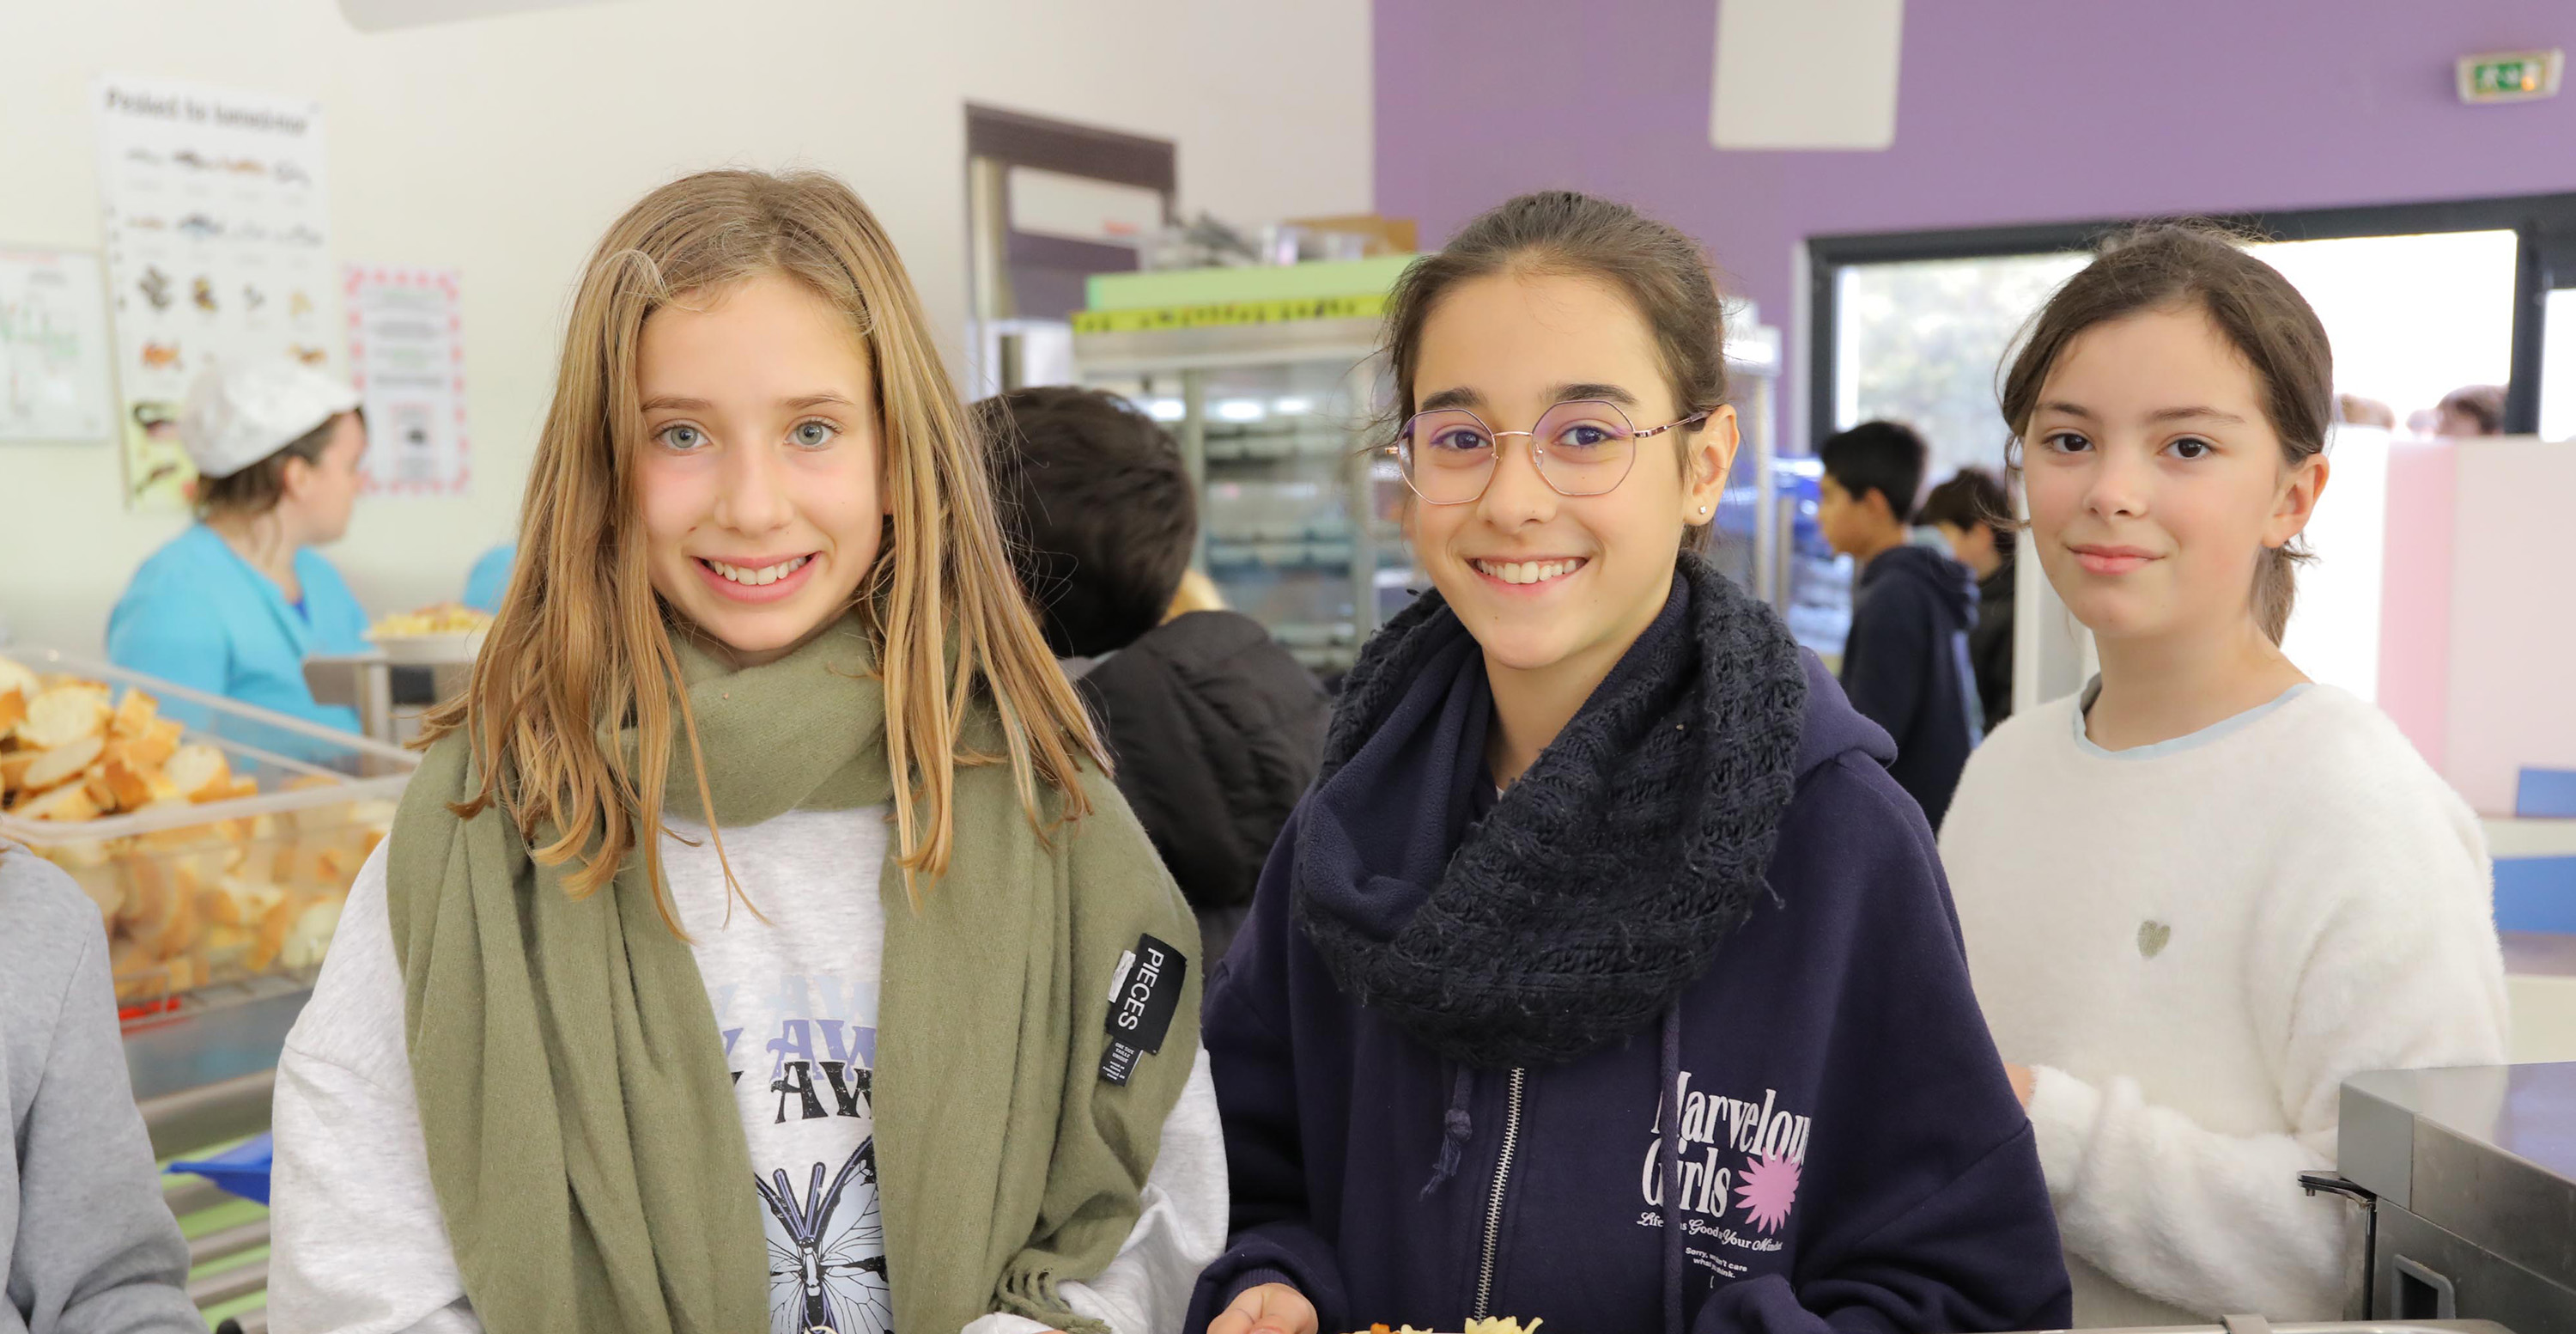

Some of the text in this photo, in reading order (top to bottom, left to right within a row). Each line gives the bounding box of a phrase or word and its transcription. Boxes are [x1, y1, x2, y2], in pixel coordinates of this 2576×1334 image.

[1118, 947, 1164, 1030] PIECES
[1650, 1070, 1812, 1166] Marvelou
[1637, 1211, 1664, 1227] Life
[1721, 1228, 1752, 1246] Your
[1728, 1262, 1747, 1272] care
